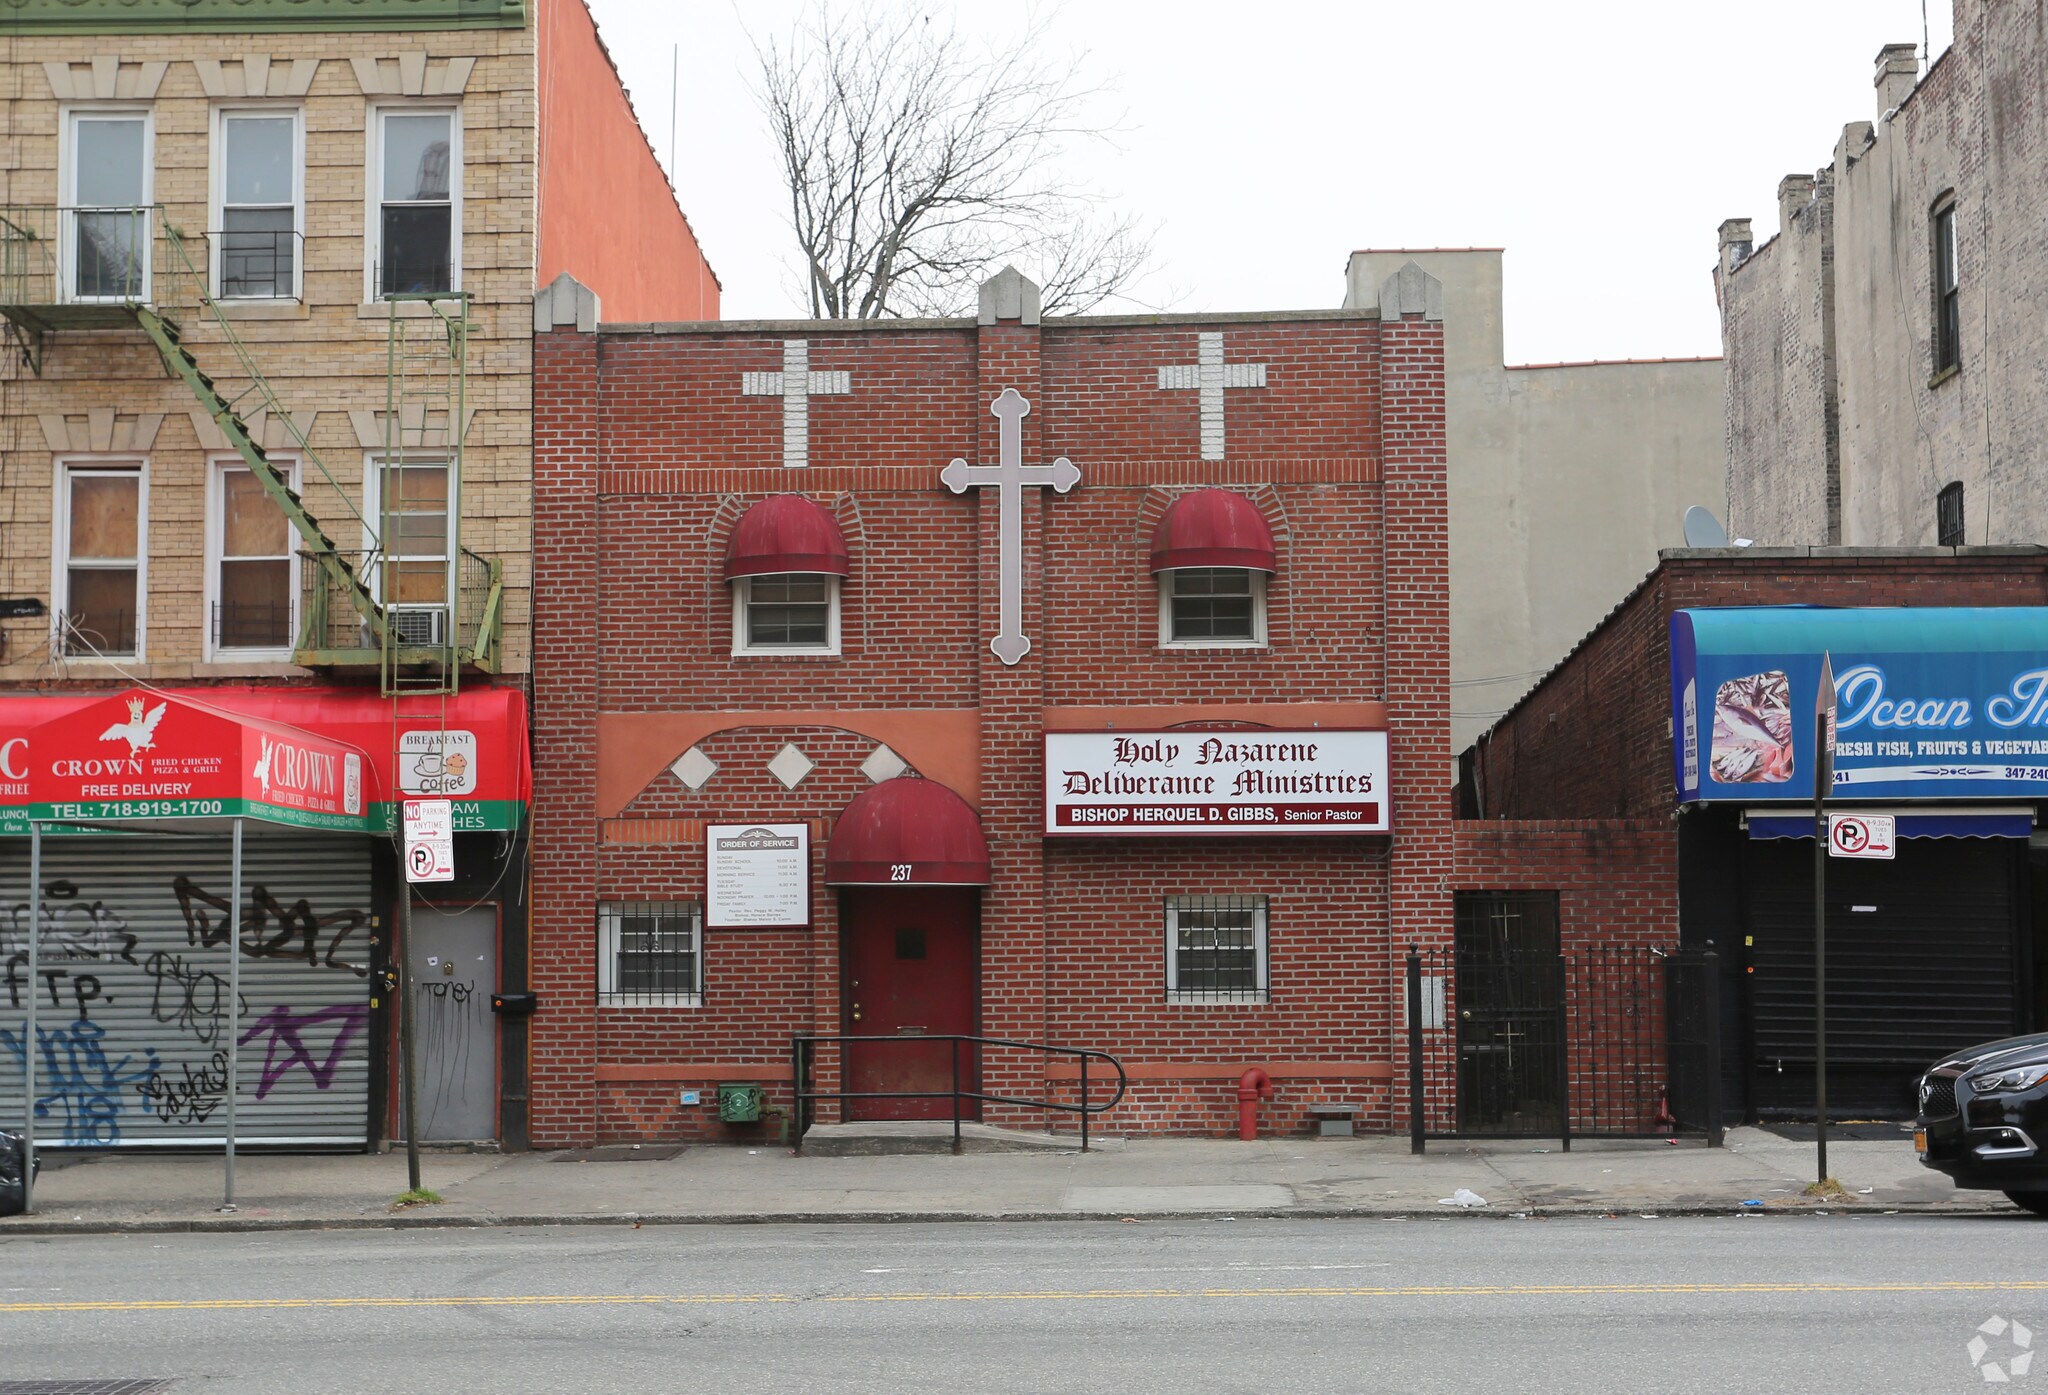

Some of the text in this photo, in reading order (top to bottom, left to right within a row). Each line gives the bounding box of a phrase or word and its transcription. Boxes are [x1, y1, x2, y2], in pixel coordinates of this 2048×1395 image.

[1835, 666, 1970, 727] Ocean
[406, 735, 471, 745] BREAKFAST
[1113, 737, 1319, 768] Holy Nazarene
[1836, 741, 1874, 756] RESH
[1877, 741, 1914, 758] FISH,
[1917, 740, 1968, 755] FRUITS
[1972, 740, 1981, 755] &
[52, 757, 222, 777] CROWN FRIED CHICKEN
[153, 765, 220, 775] PIZZA & GRILL
[273, 742, 335, 796] CROWN
[81, 782, 192, 797] FREE DELIVERY
[1062, 769, 1373, 797] Deliverance Ministries
[50, 800, 222, 818] TEL: 718-919-1700
[406, 805, 420, 819] NO
[422, 807, 448, 816] PARKING
[1071, 807, 1362, 823] BISHOP HERQUEL D. GIBBS, Senior Pastor
[413, 821, 444, 829] ANYTIME
[749, 840, 760, 848] OF
[891, 865, 912, 881] 237
